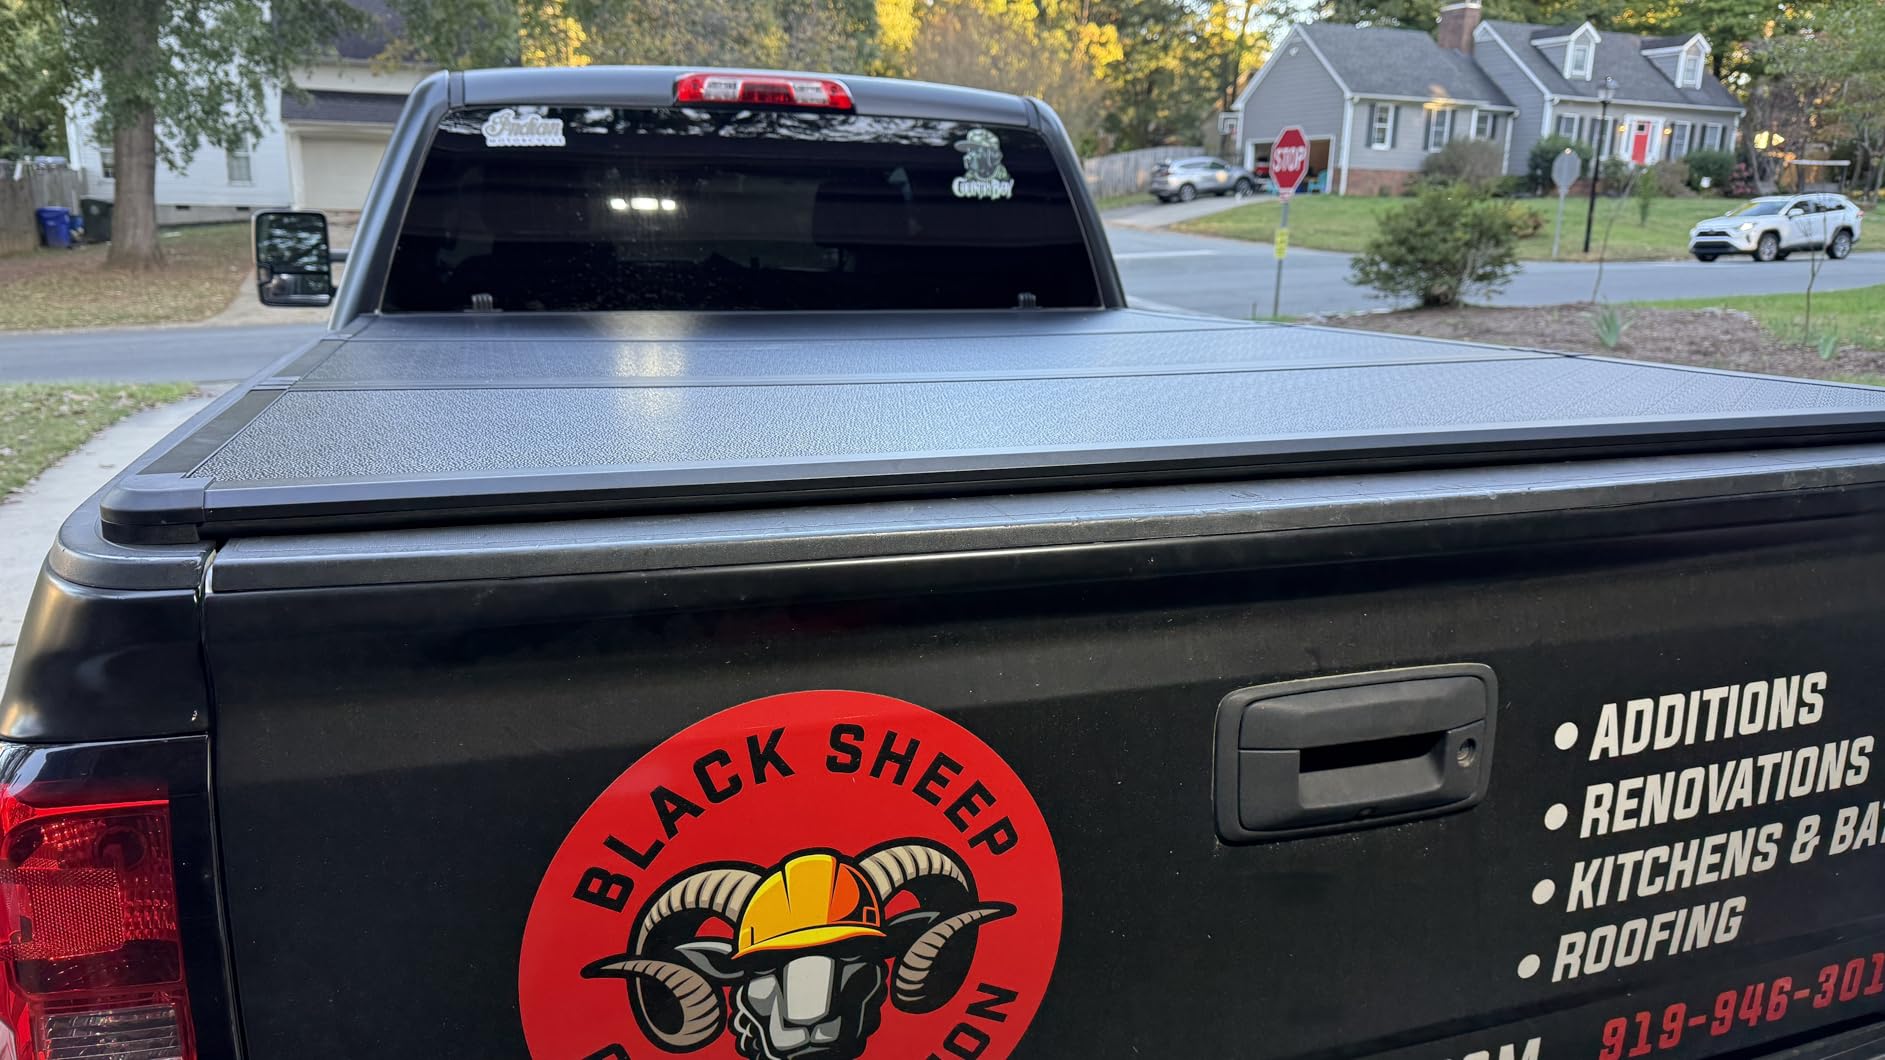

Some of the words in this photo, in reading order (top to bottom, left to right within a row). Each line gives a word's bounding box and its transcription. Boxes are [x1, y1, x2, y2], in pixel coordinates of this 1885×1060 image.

[484, 110, 562, 136] Indian
[1273, 145, 1306, 172] STOP
[1589, 671, 1828, 761] ADDITIONS
[572, 727, 795, 913] BLACK
[825, 723, 1019, 856] SHEEP
[1579, 735, 1875, 839] RENOVATIONS
[1566, 822, 1783, 912] KITCHENS
[1790, 814, 1821, 864] &
[1828, 800, 1885, 856] BA
[1551, 896, 1747, 982] ROOFING
